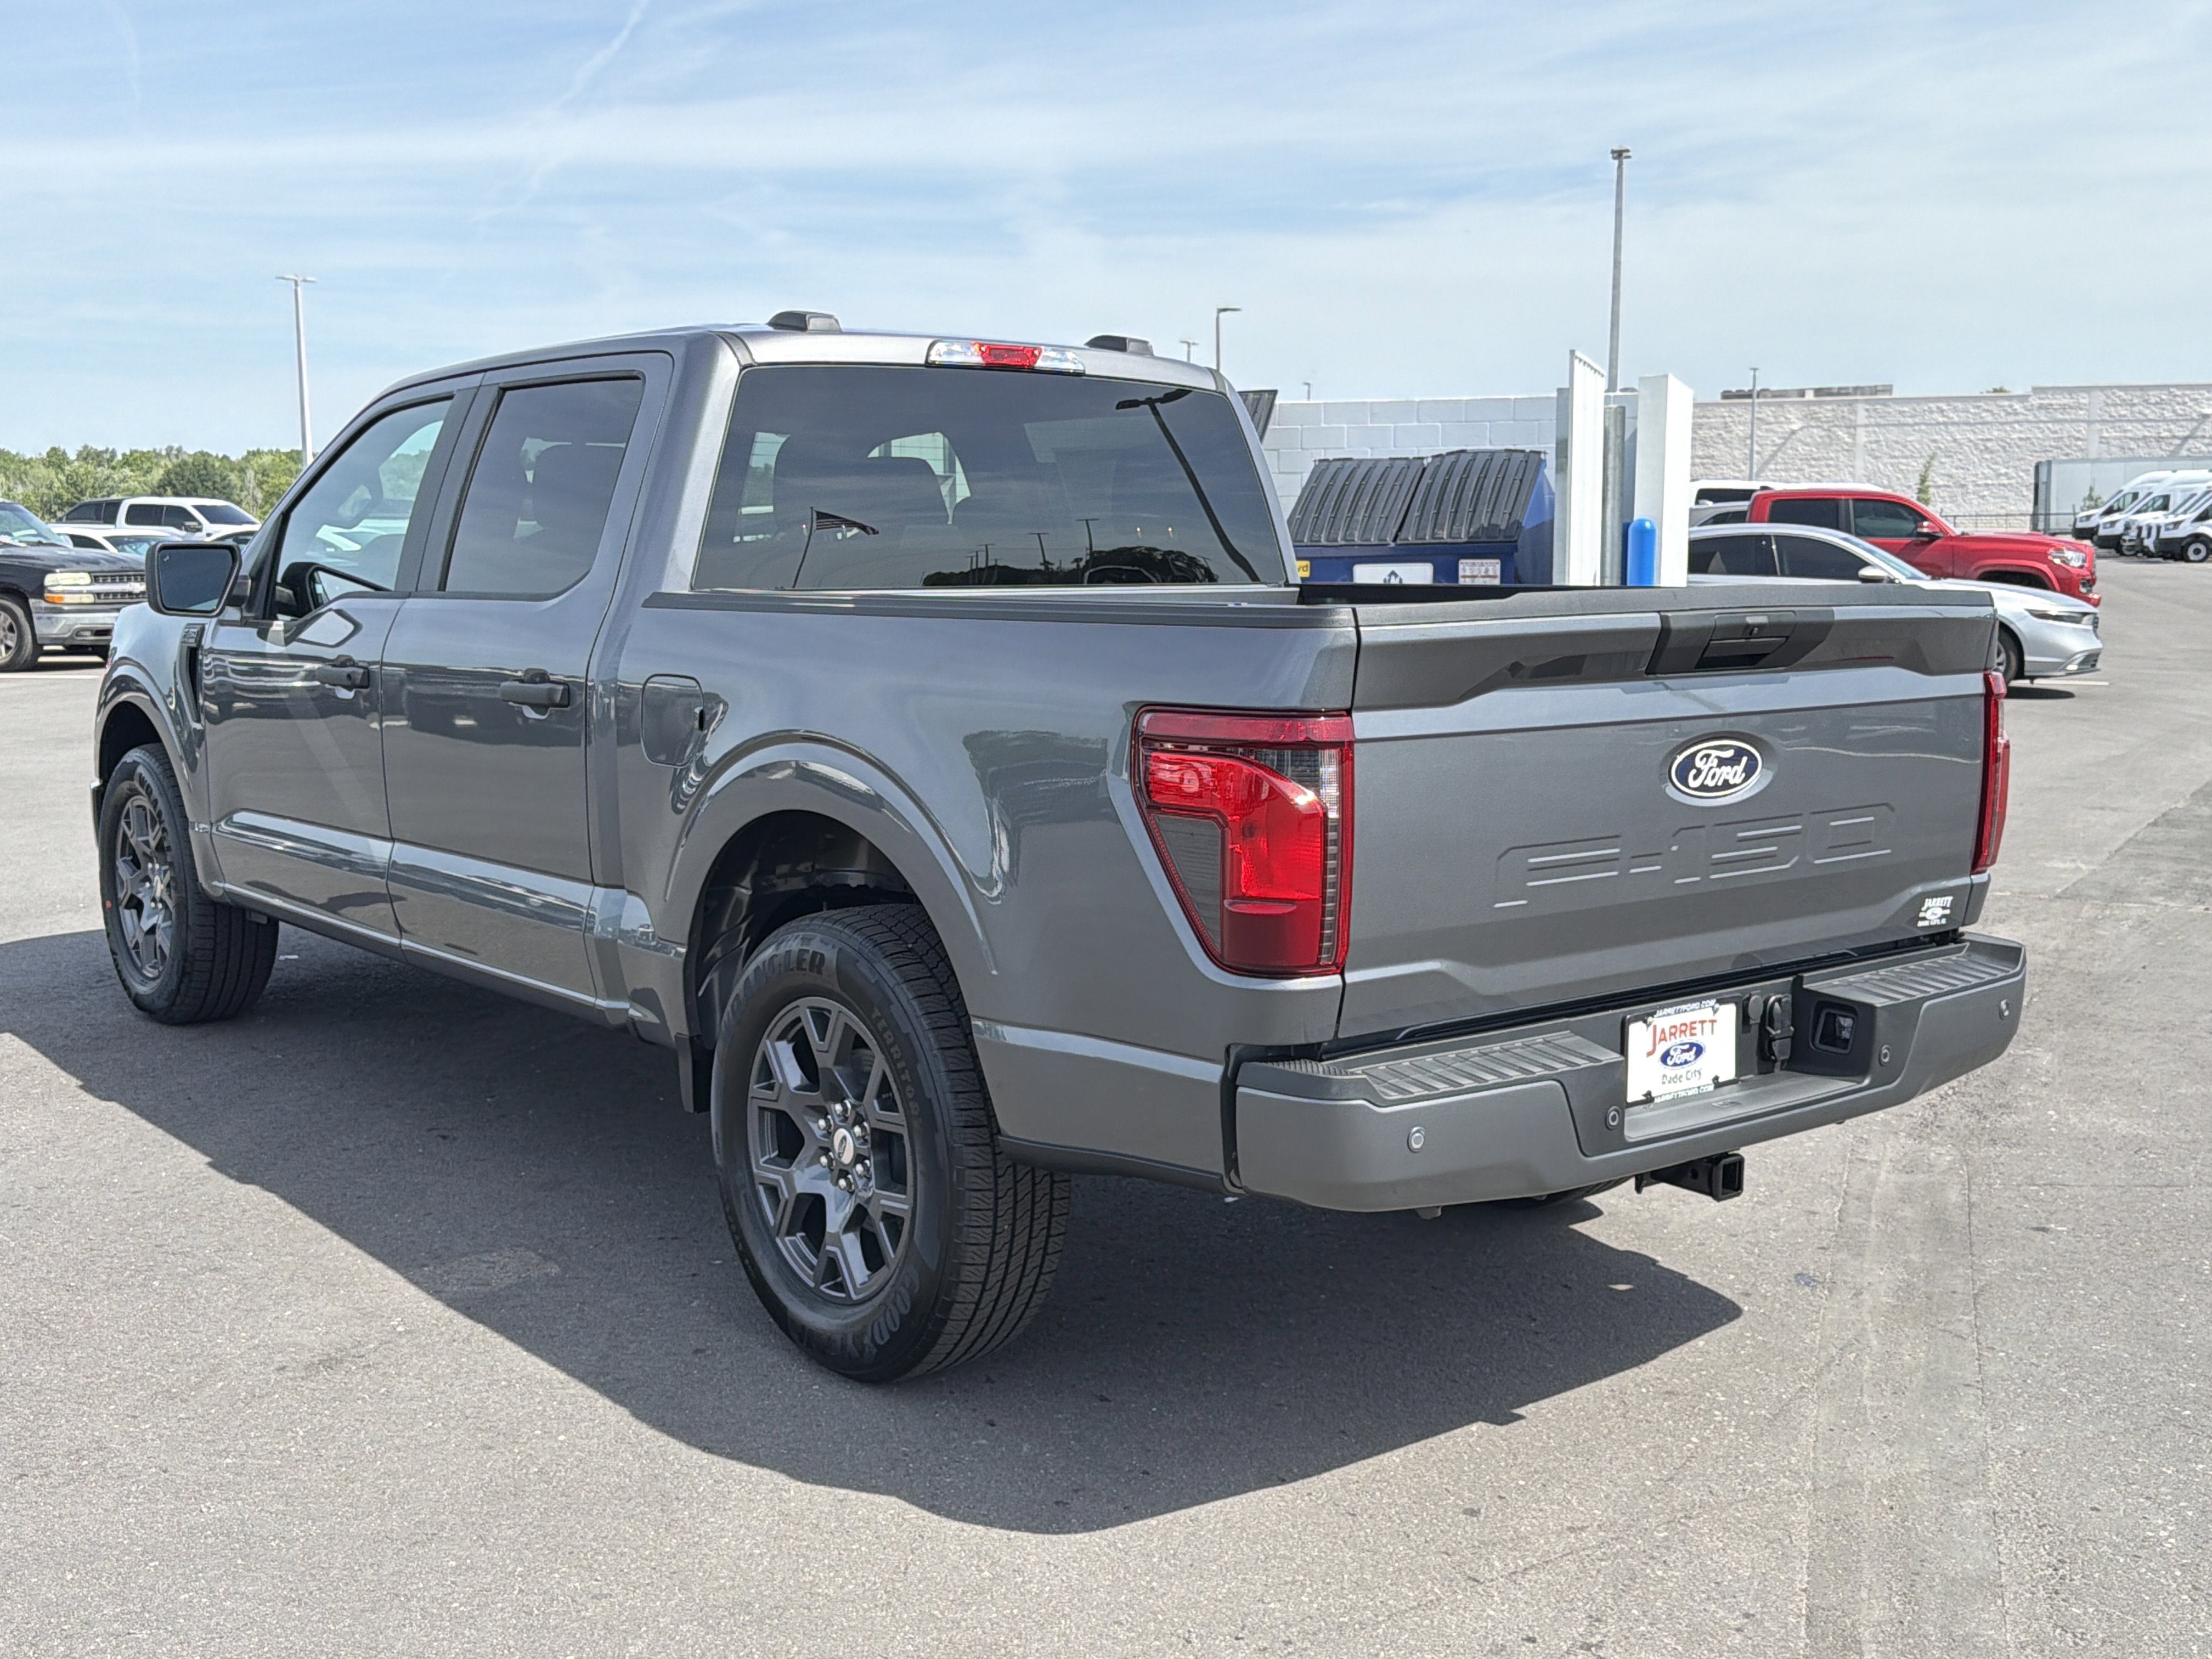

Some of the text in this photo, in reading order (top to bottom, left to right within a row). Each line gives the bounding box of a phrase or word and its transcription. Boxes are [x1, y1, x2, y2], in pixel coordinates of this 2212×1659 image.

[1688, 749, 1748, 788] Ford
[1493, 803, 1895, 907] F-150
[1646, 1019, 1717, 1058] JARRETT
[1667, 1044, 1696, 1065] Ford
[1662, 1069, 1702, 1085] Dade City
